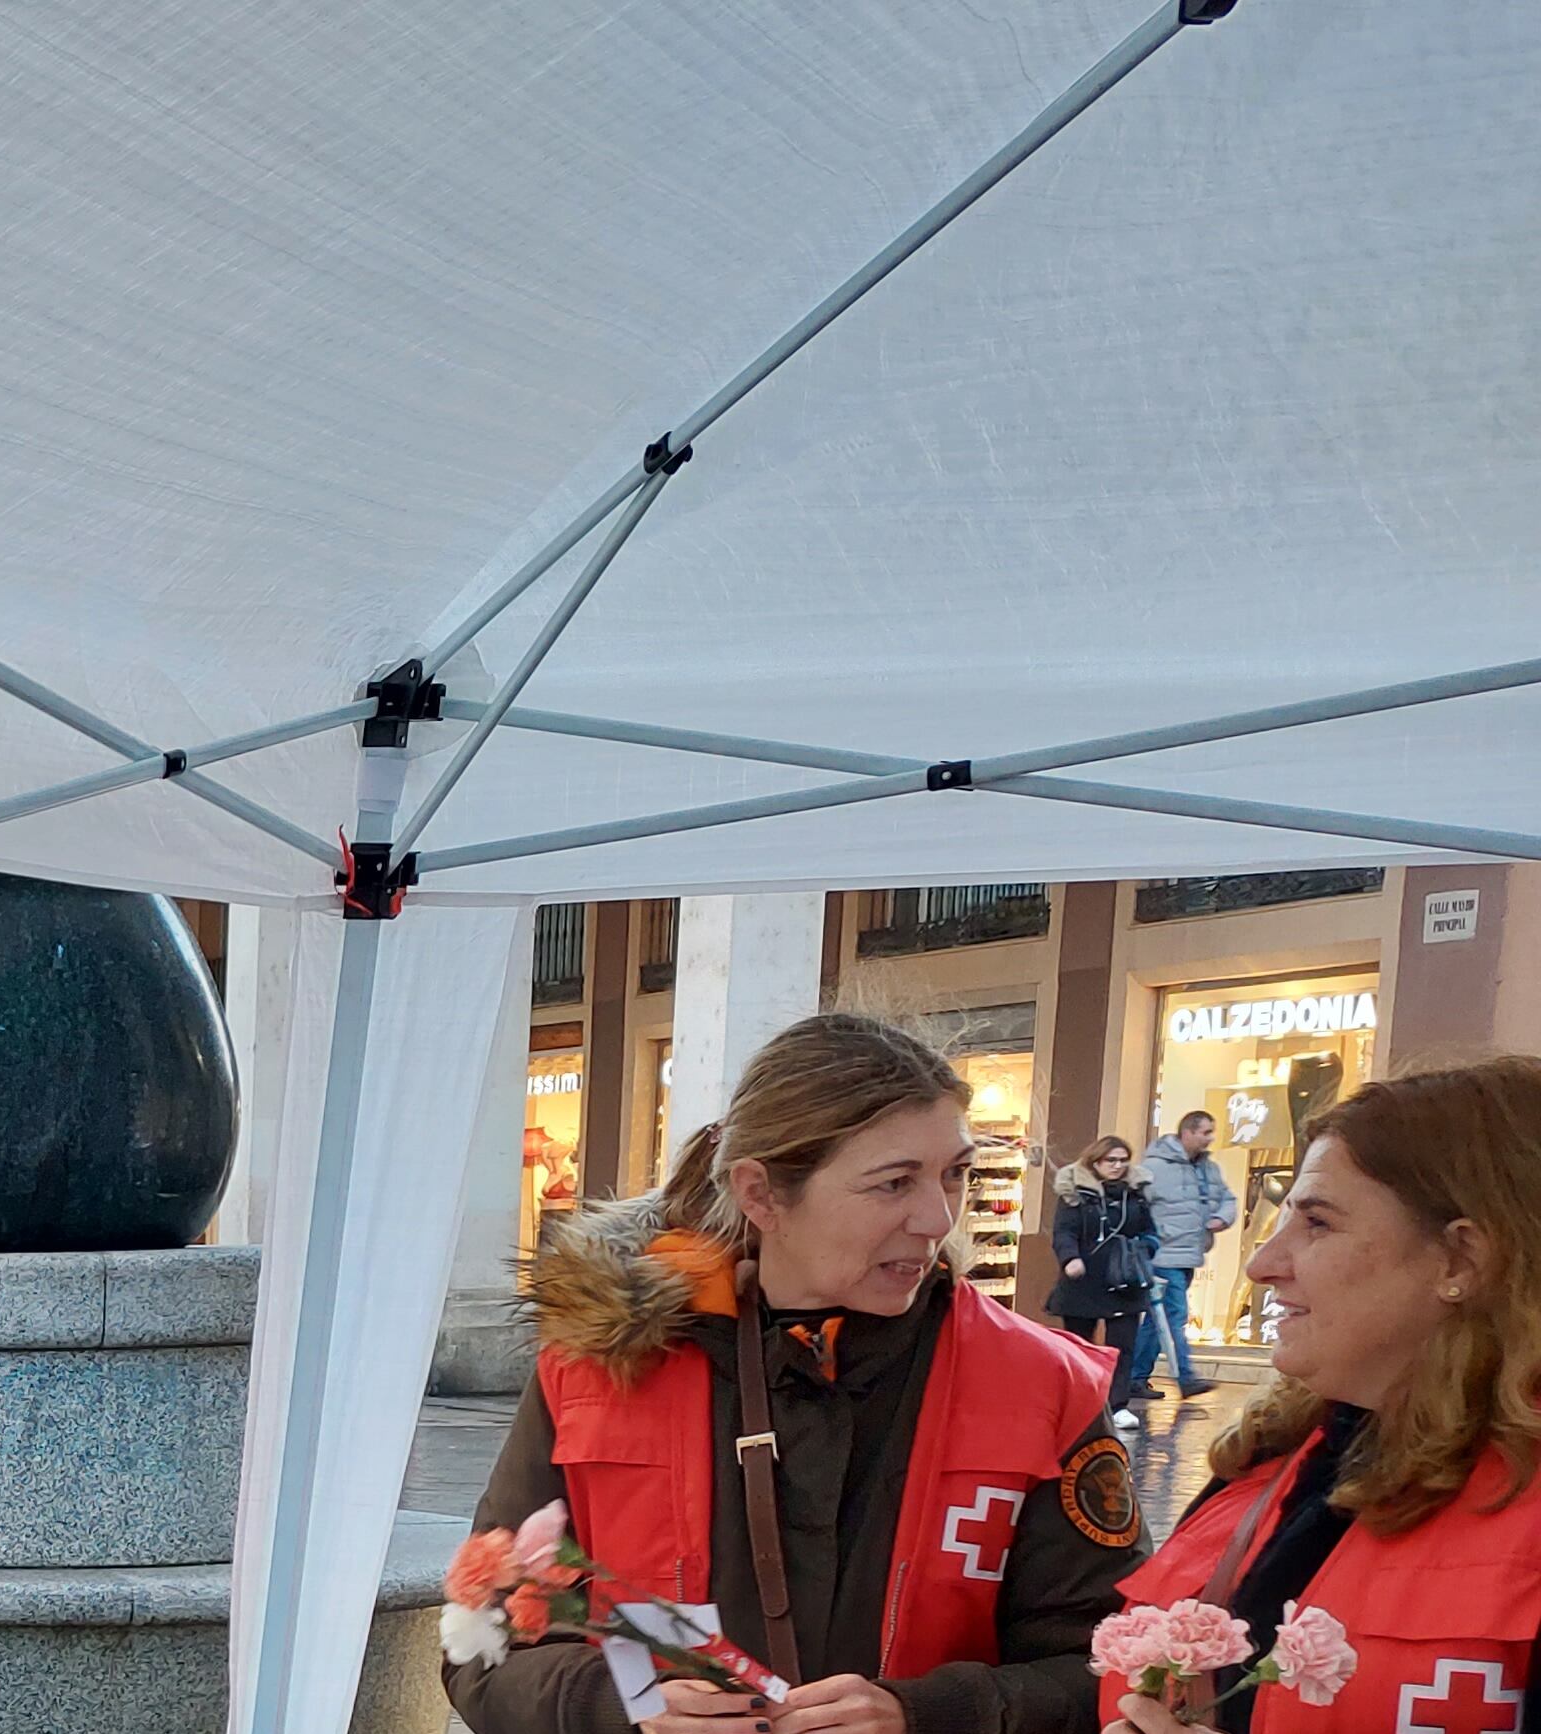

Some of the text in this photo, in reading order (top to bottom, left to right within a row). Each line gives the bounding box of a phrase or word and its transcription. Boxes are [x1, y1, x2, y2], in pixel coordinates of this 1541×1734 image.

[1429, 902, 1449, 915] CALLE
[1433, 917, 1466, 933] PRINCIPAL
[1169, 992, 1378, 1044] CALZEDONIA
